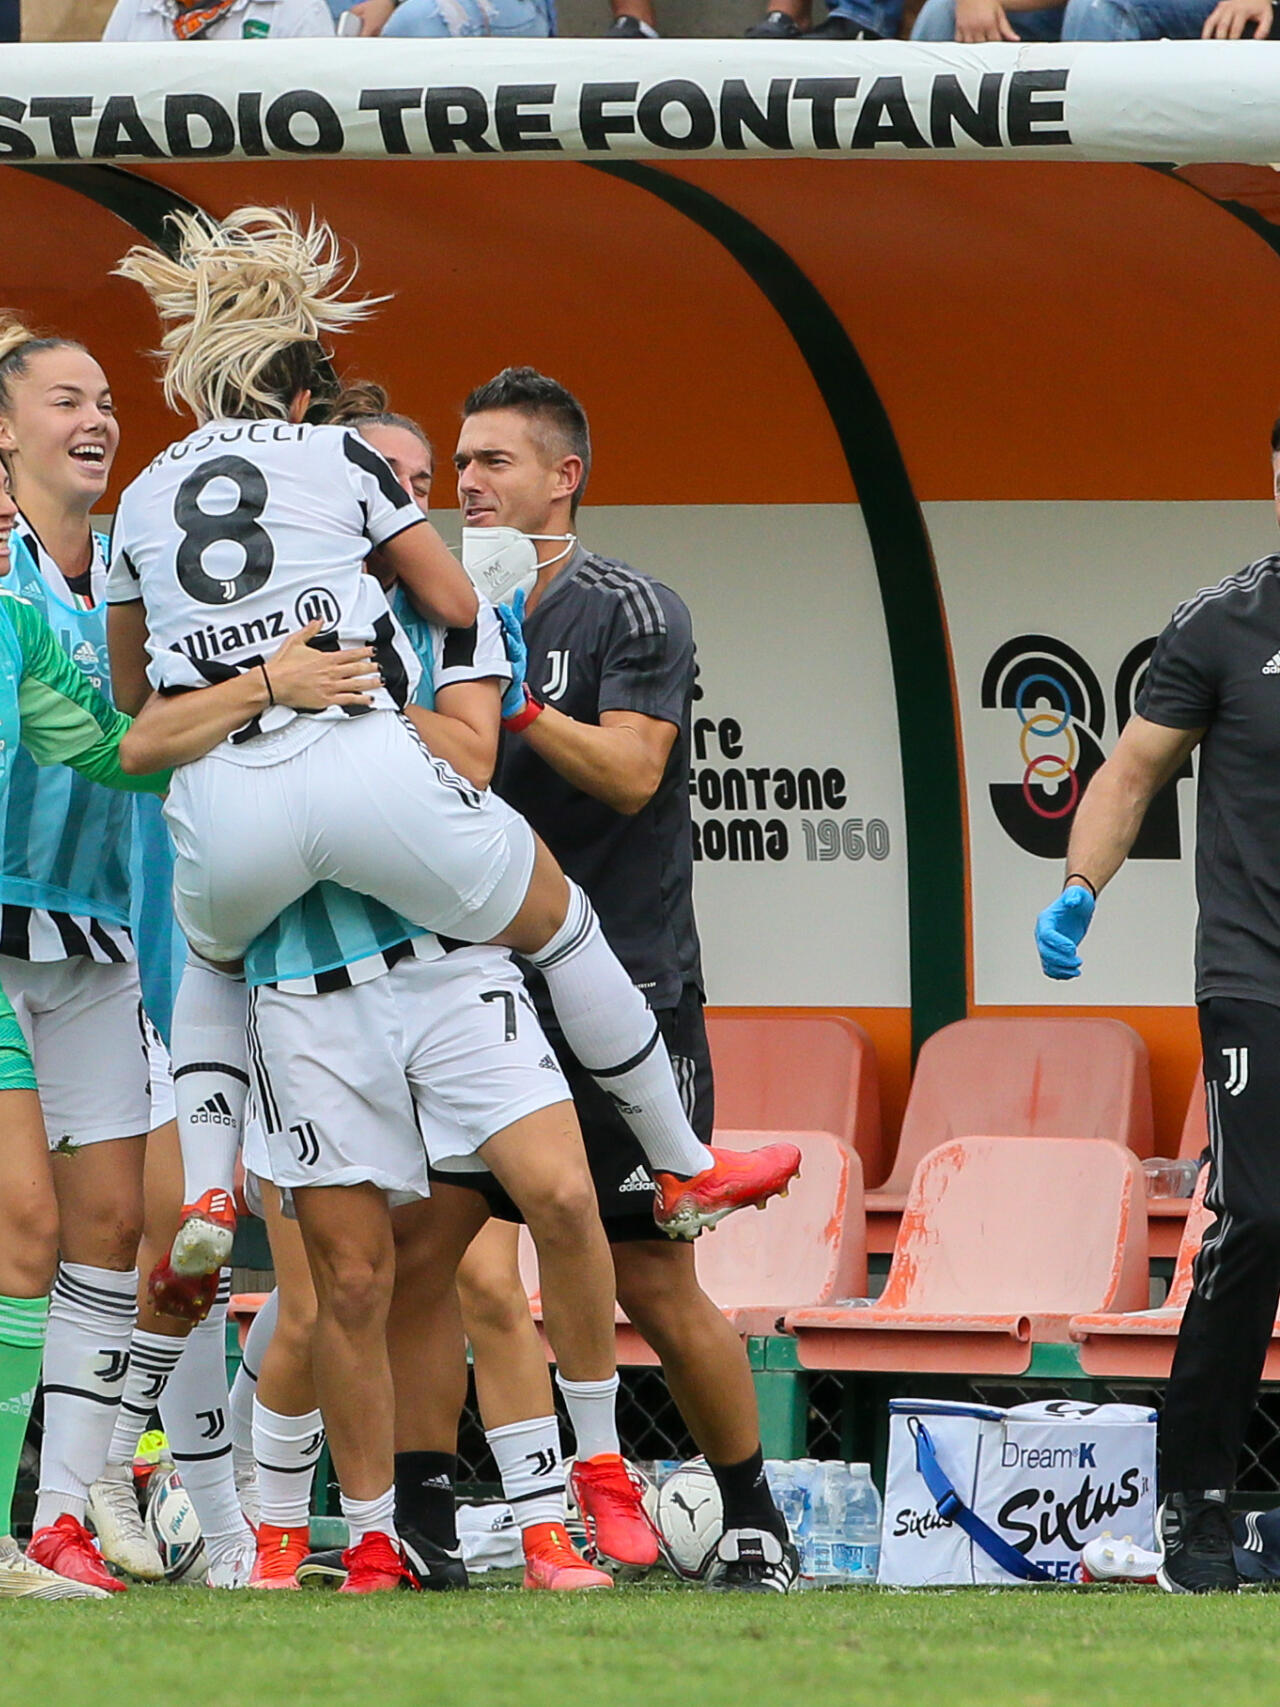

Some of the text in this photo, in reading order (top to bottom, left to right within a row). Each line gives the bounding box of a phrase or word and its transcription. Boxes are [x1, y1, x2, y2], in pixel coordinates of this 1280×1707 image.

[359, 84, 563, 155] TRE
[578, 69, 1073, 151] FONTANE
[174, 454, 274, 606] 8
[801, 818, 891, 861] 1960
[479, 990, 517, 1042] 7
[190, 1114, 237, 1129] adidas
[618, 1181, 657, 1193] adidas
